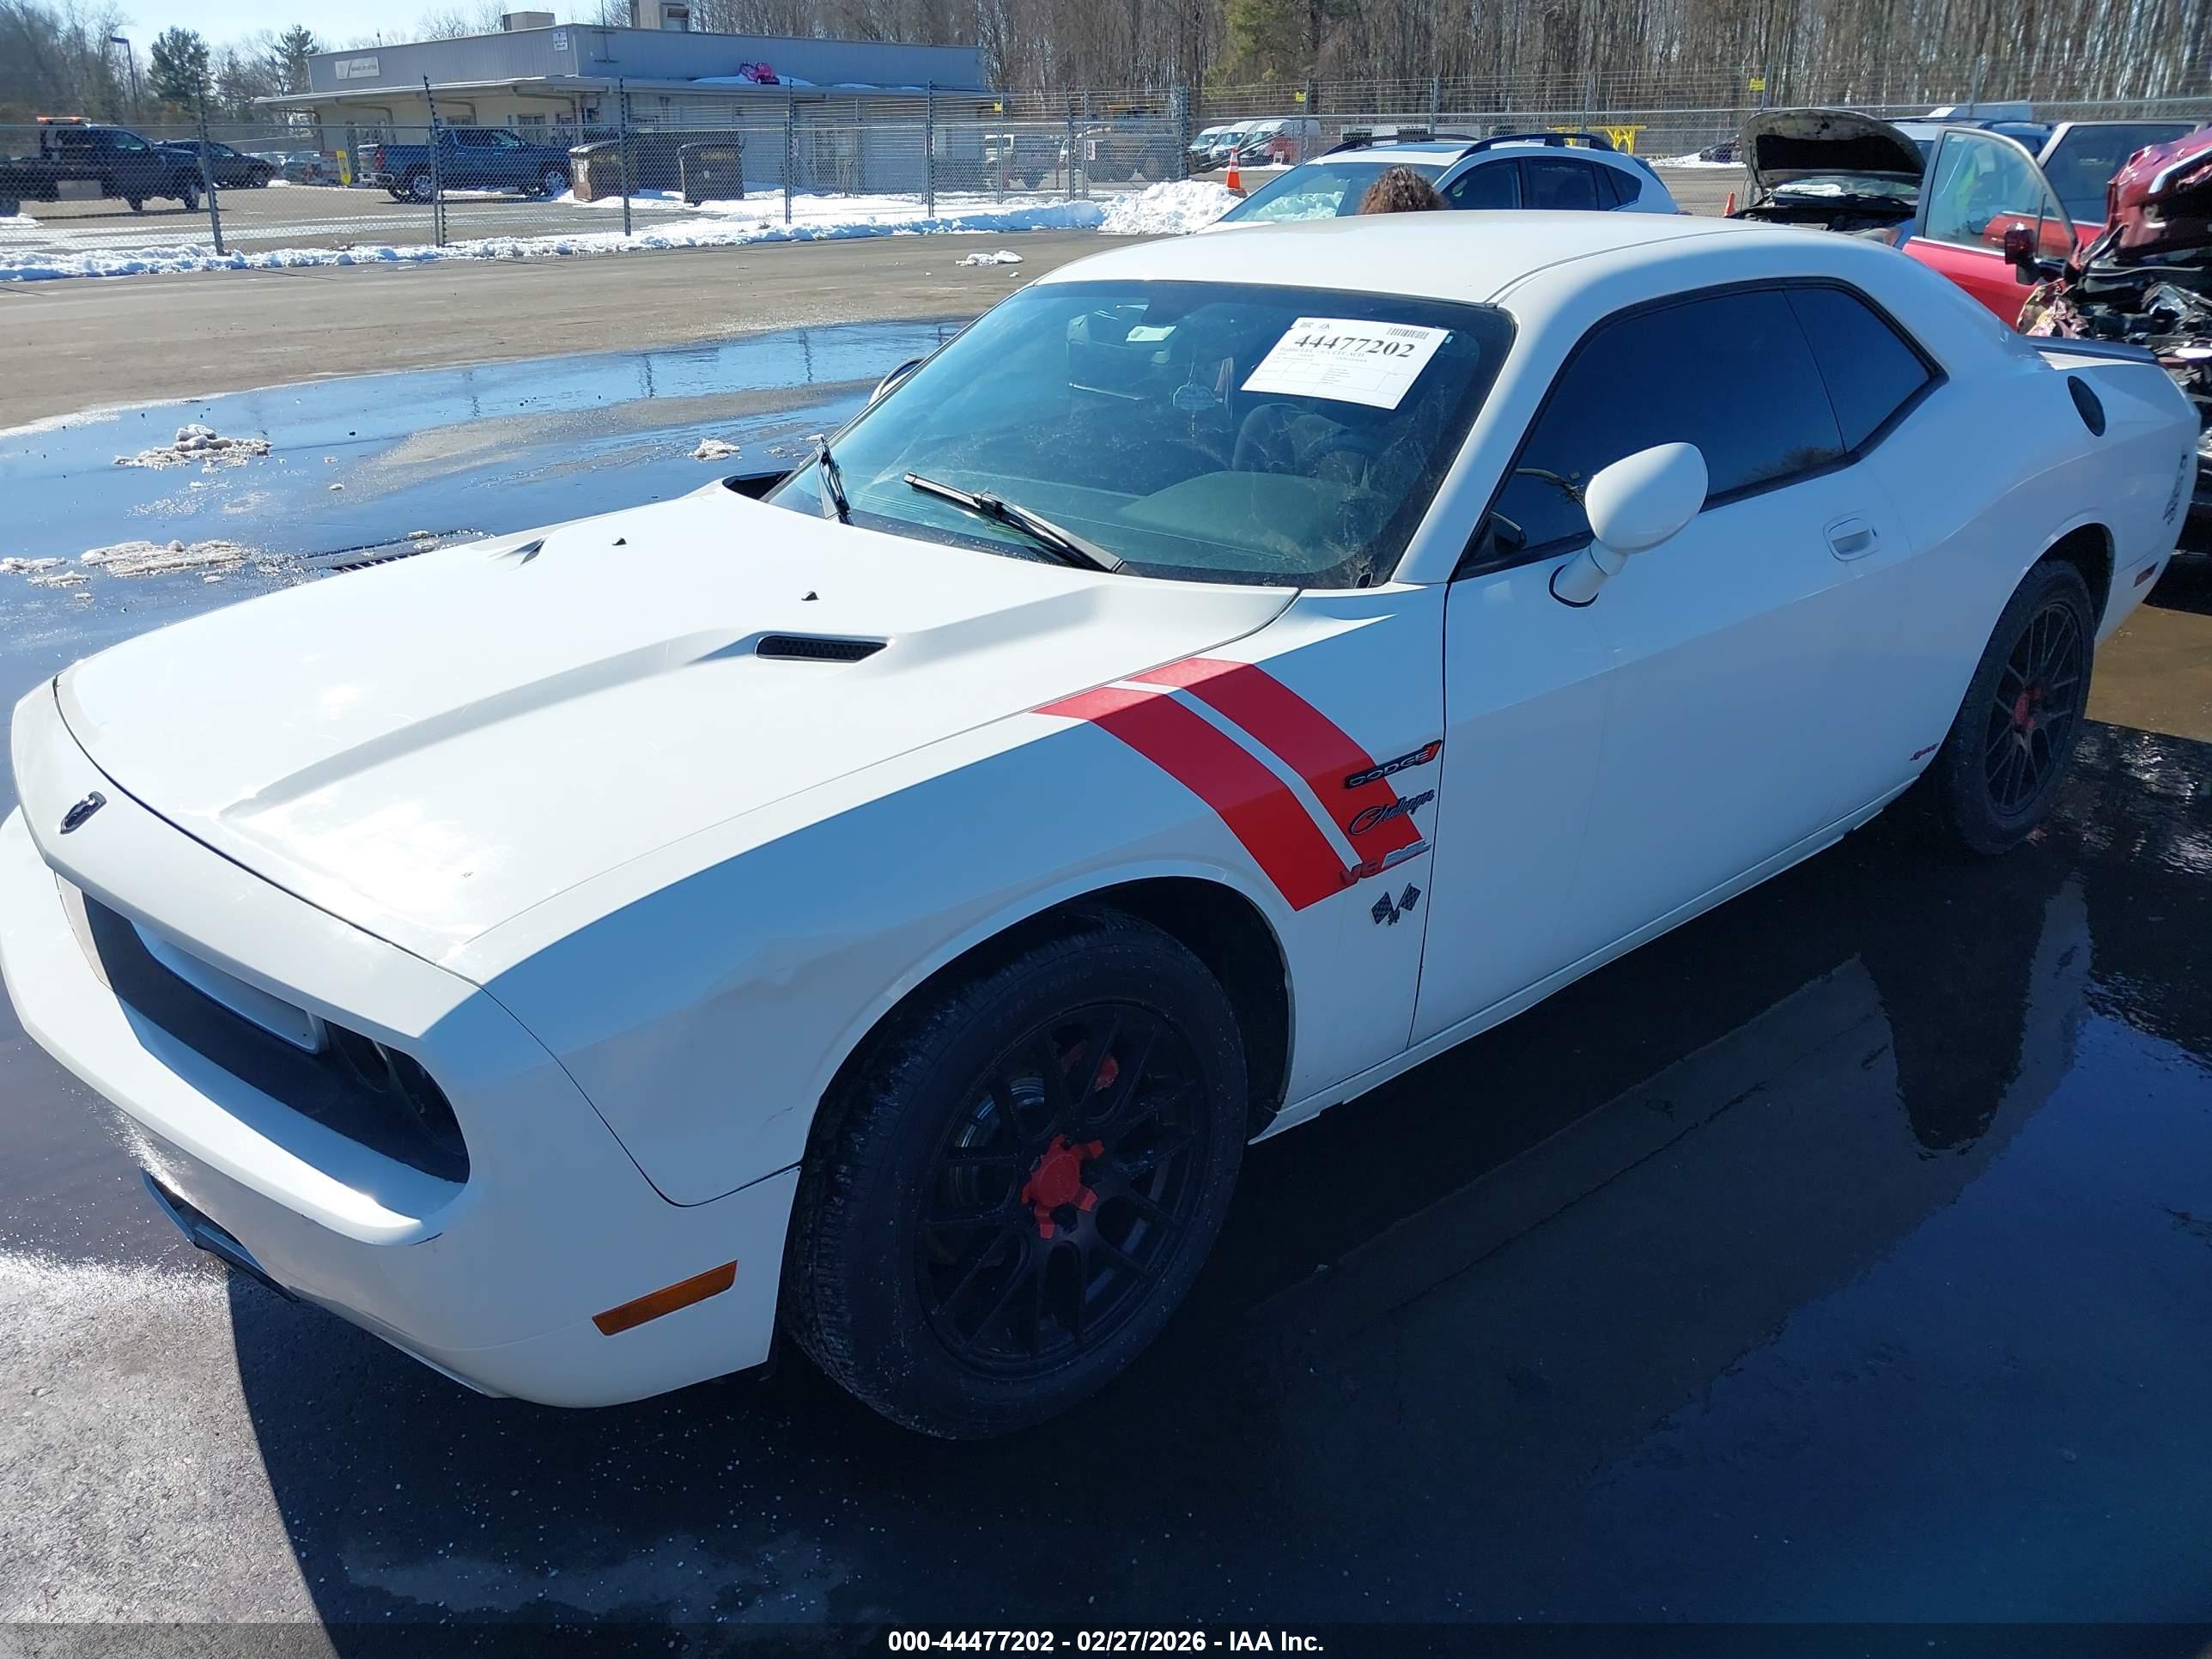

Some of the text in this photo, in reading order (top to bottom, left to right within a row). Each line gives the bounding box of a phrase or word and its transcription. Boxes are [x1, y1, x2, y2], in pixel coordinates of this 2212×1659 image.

[1294, 333, 1417, 359] 44477202
[1349, 750, 1431, 787] DODGE
[1349, 788, 1436, 836] Challenger
